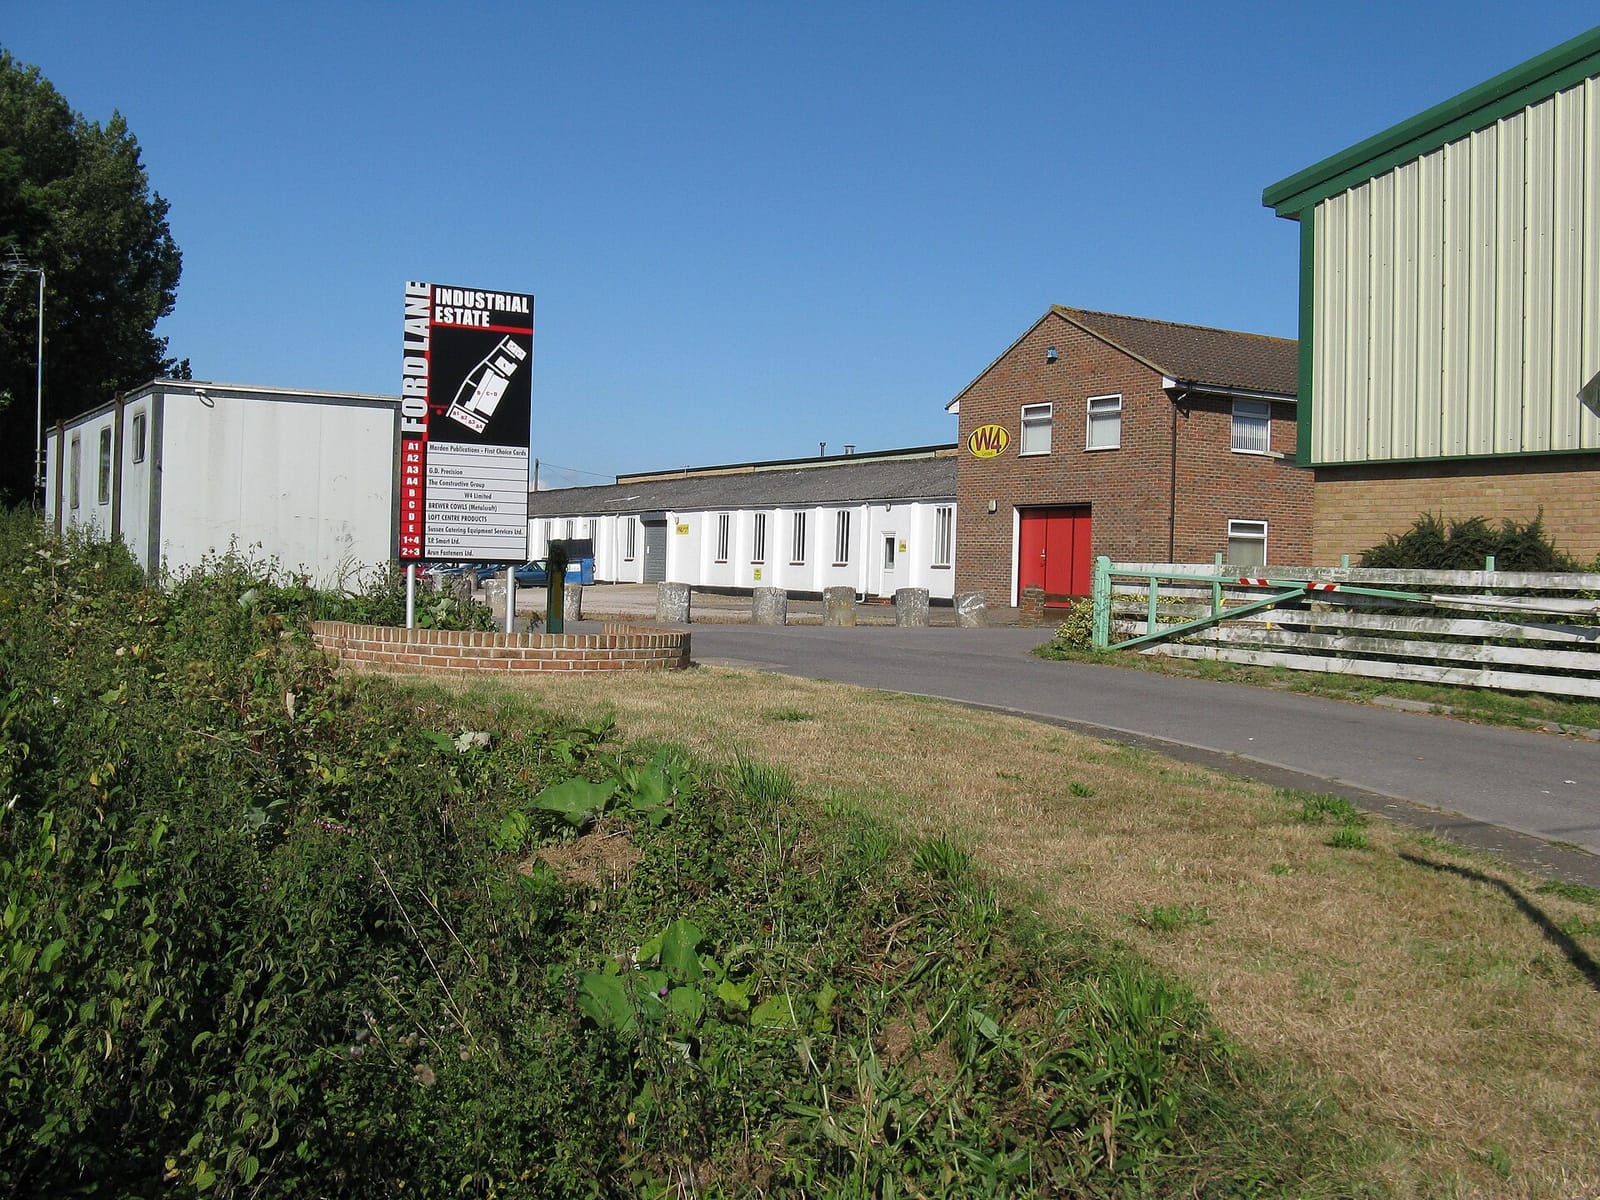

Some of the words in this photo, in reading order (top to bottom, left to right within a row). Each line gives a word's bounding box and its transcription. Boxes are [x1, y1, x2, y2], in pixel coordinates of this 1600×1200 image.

[435, 287, 529, 314] INDUSTRIAL
[404, 281, 431, 351] LANE
[435, 306, 490, 327] ESTATE
[401, 356, 429, 432] FORD
[975, 427, 1002, 453] W4
[408, 442, 418, 450] A1
[450, 445, 480, 454] Publications
[513, 448, 526, 456] Cards
[407, 454, 419, 462] A2
[406, 466, 418, 474] A3
[406, 478, 418, 486] A4
[438, 480, 468, 488] Constructive
[470, 481, 485, 489] Group
[408, 488, 416, 496] B
[408, 500, 416, 508] C
[408, 512, 415, 520] D
[408, 524, 414, 532] E
[444, 526, 466, 534] Catering
[467, 526, 494, 535] Equipment
[403, 536, 420, 544] 1+4
[402, 548, 420, 556] 2+3
